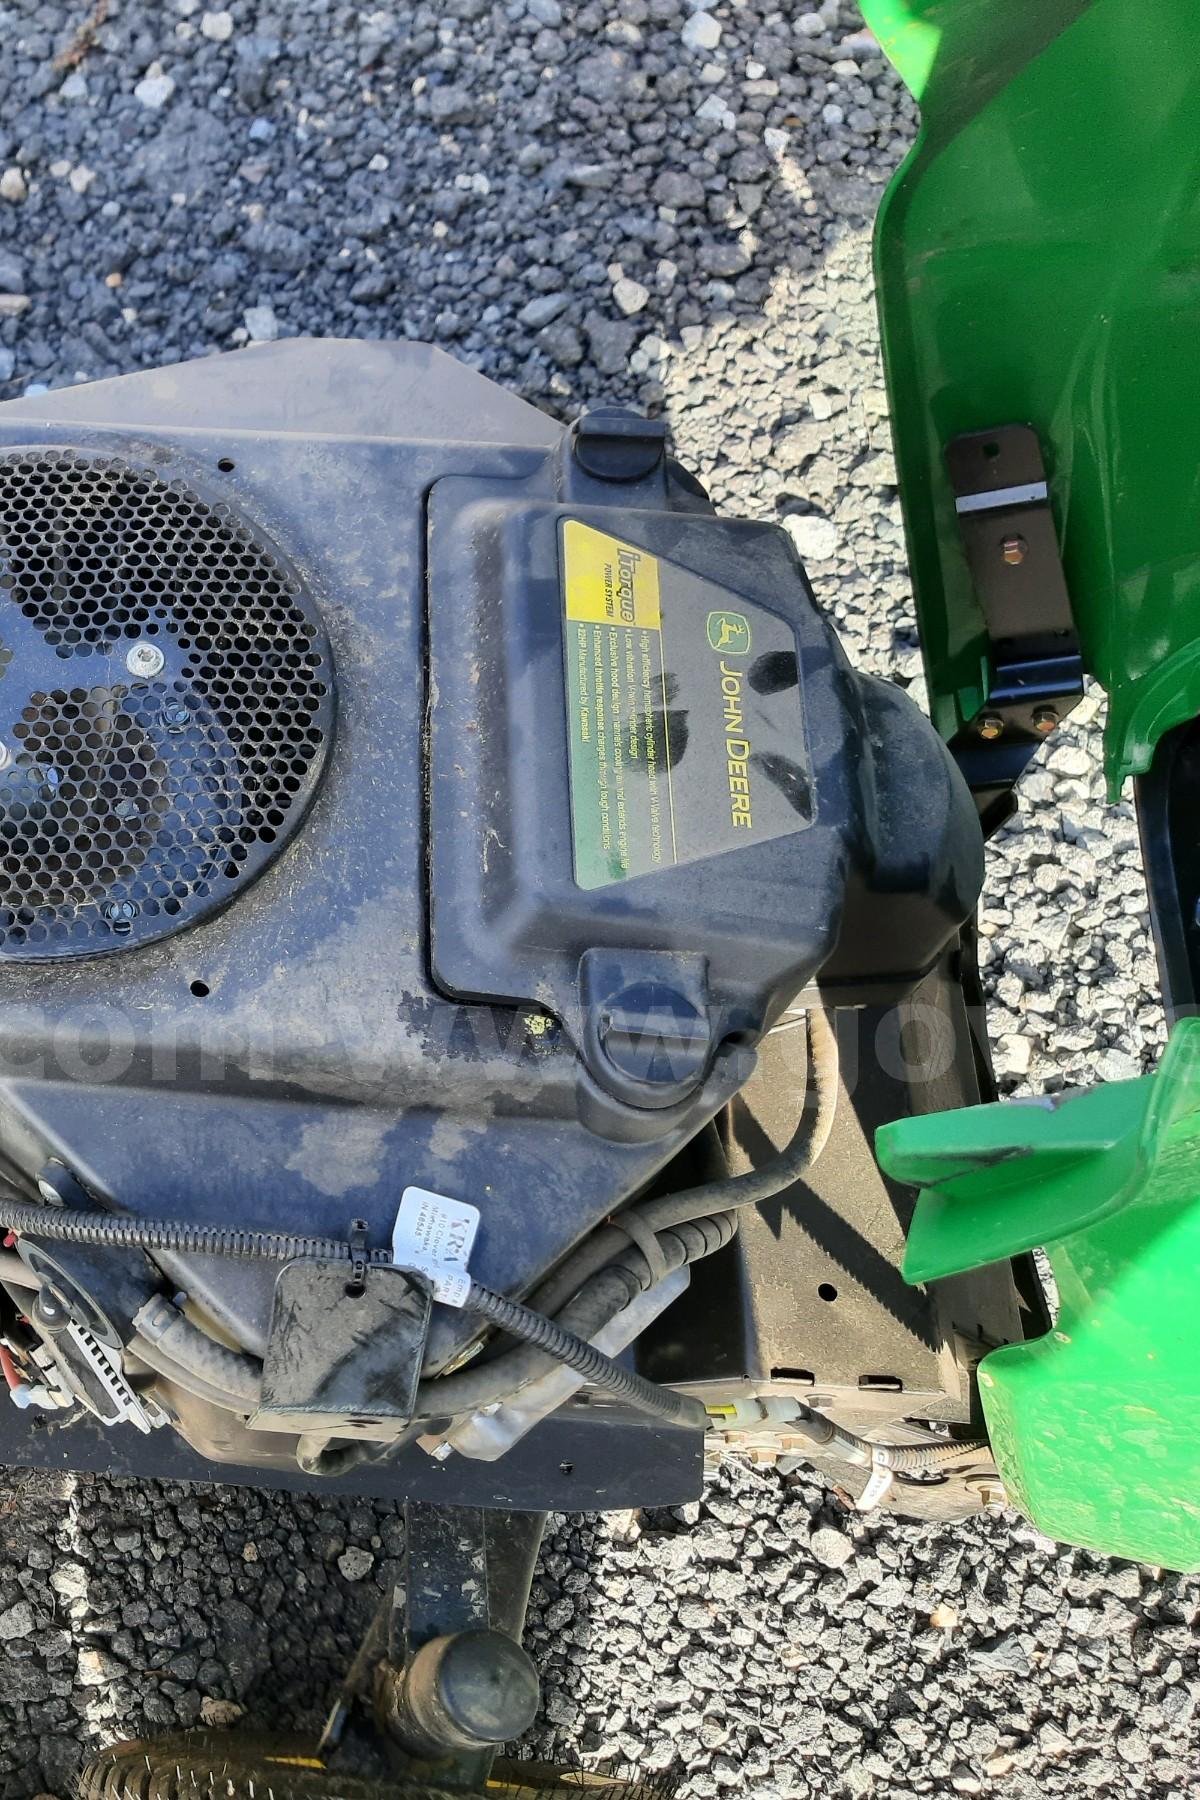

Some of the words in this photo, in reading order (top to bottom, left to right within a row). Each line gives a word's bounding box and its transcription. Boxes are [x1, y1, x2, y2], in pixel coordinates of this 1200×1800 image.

[604, 563, 612, 588] POWER
[616, 549, 640, 622] iTorque
[604, 589, 614, 617] SYSTEM
[592, 630, 602, 666] Enhanced
[608, 631, 618, 666] Exclusive
[624, 633, 632, 648] Low
[639, 634, 650, 652] High
[577, 648, 588, 695] Manufactured
[594, 667, 604, 694] throttle
[610, 668, 619, 687] hood
[625, 650, 635, 682] vibration
[640, 653, 652, 688] efficiency
[579, 696, 588, 704] by
[720, 661, 743, 733] JOHN
[579, 706, 590, 742] Kawasaki
[594, 695, 606, 730] response
[596, 731, 607, 760] charges
[612, 717, 622, 746] hannels
[644, 732, 656, 759] cylinder
[628, 735, 639, 758] design
[726, 738, 752, 829] DEERE
[598, 790, 609, 811] tough
[617, 801, 627, 829] extends
[649, 824, 661, 864] technology
